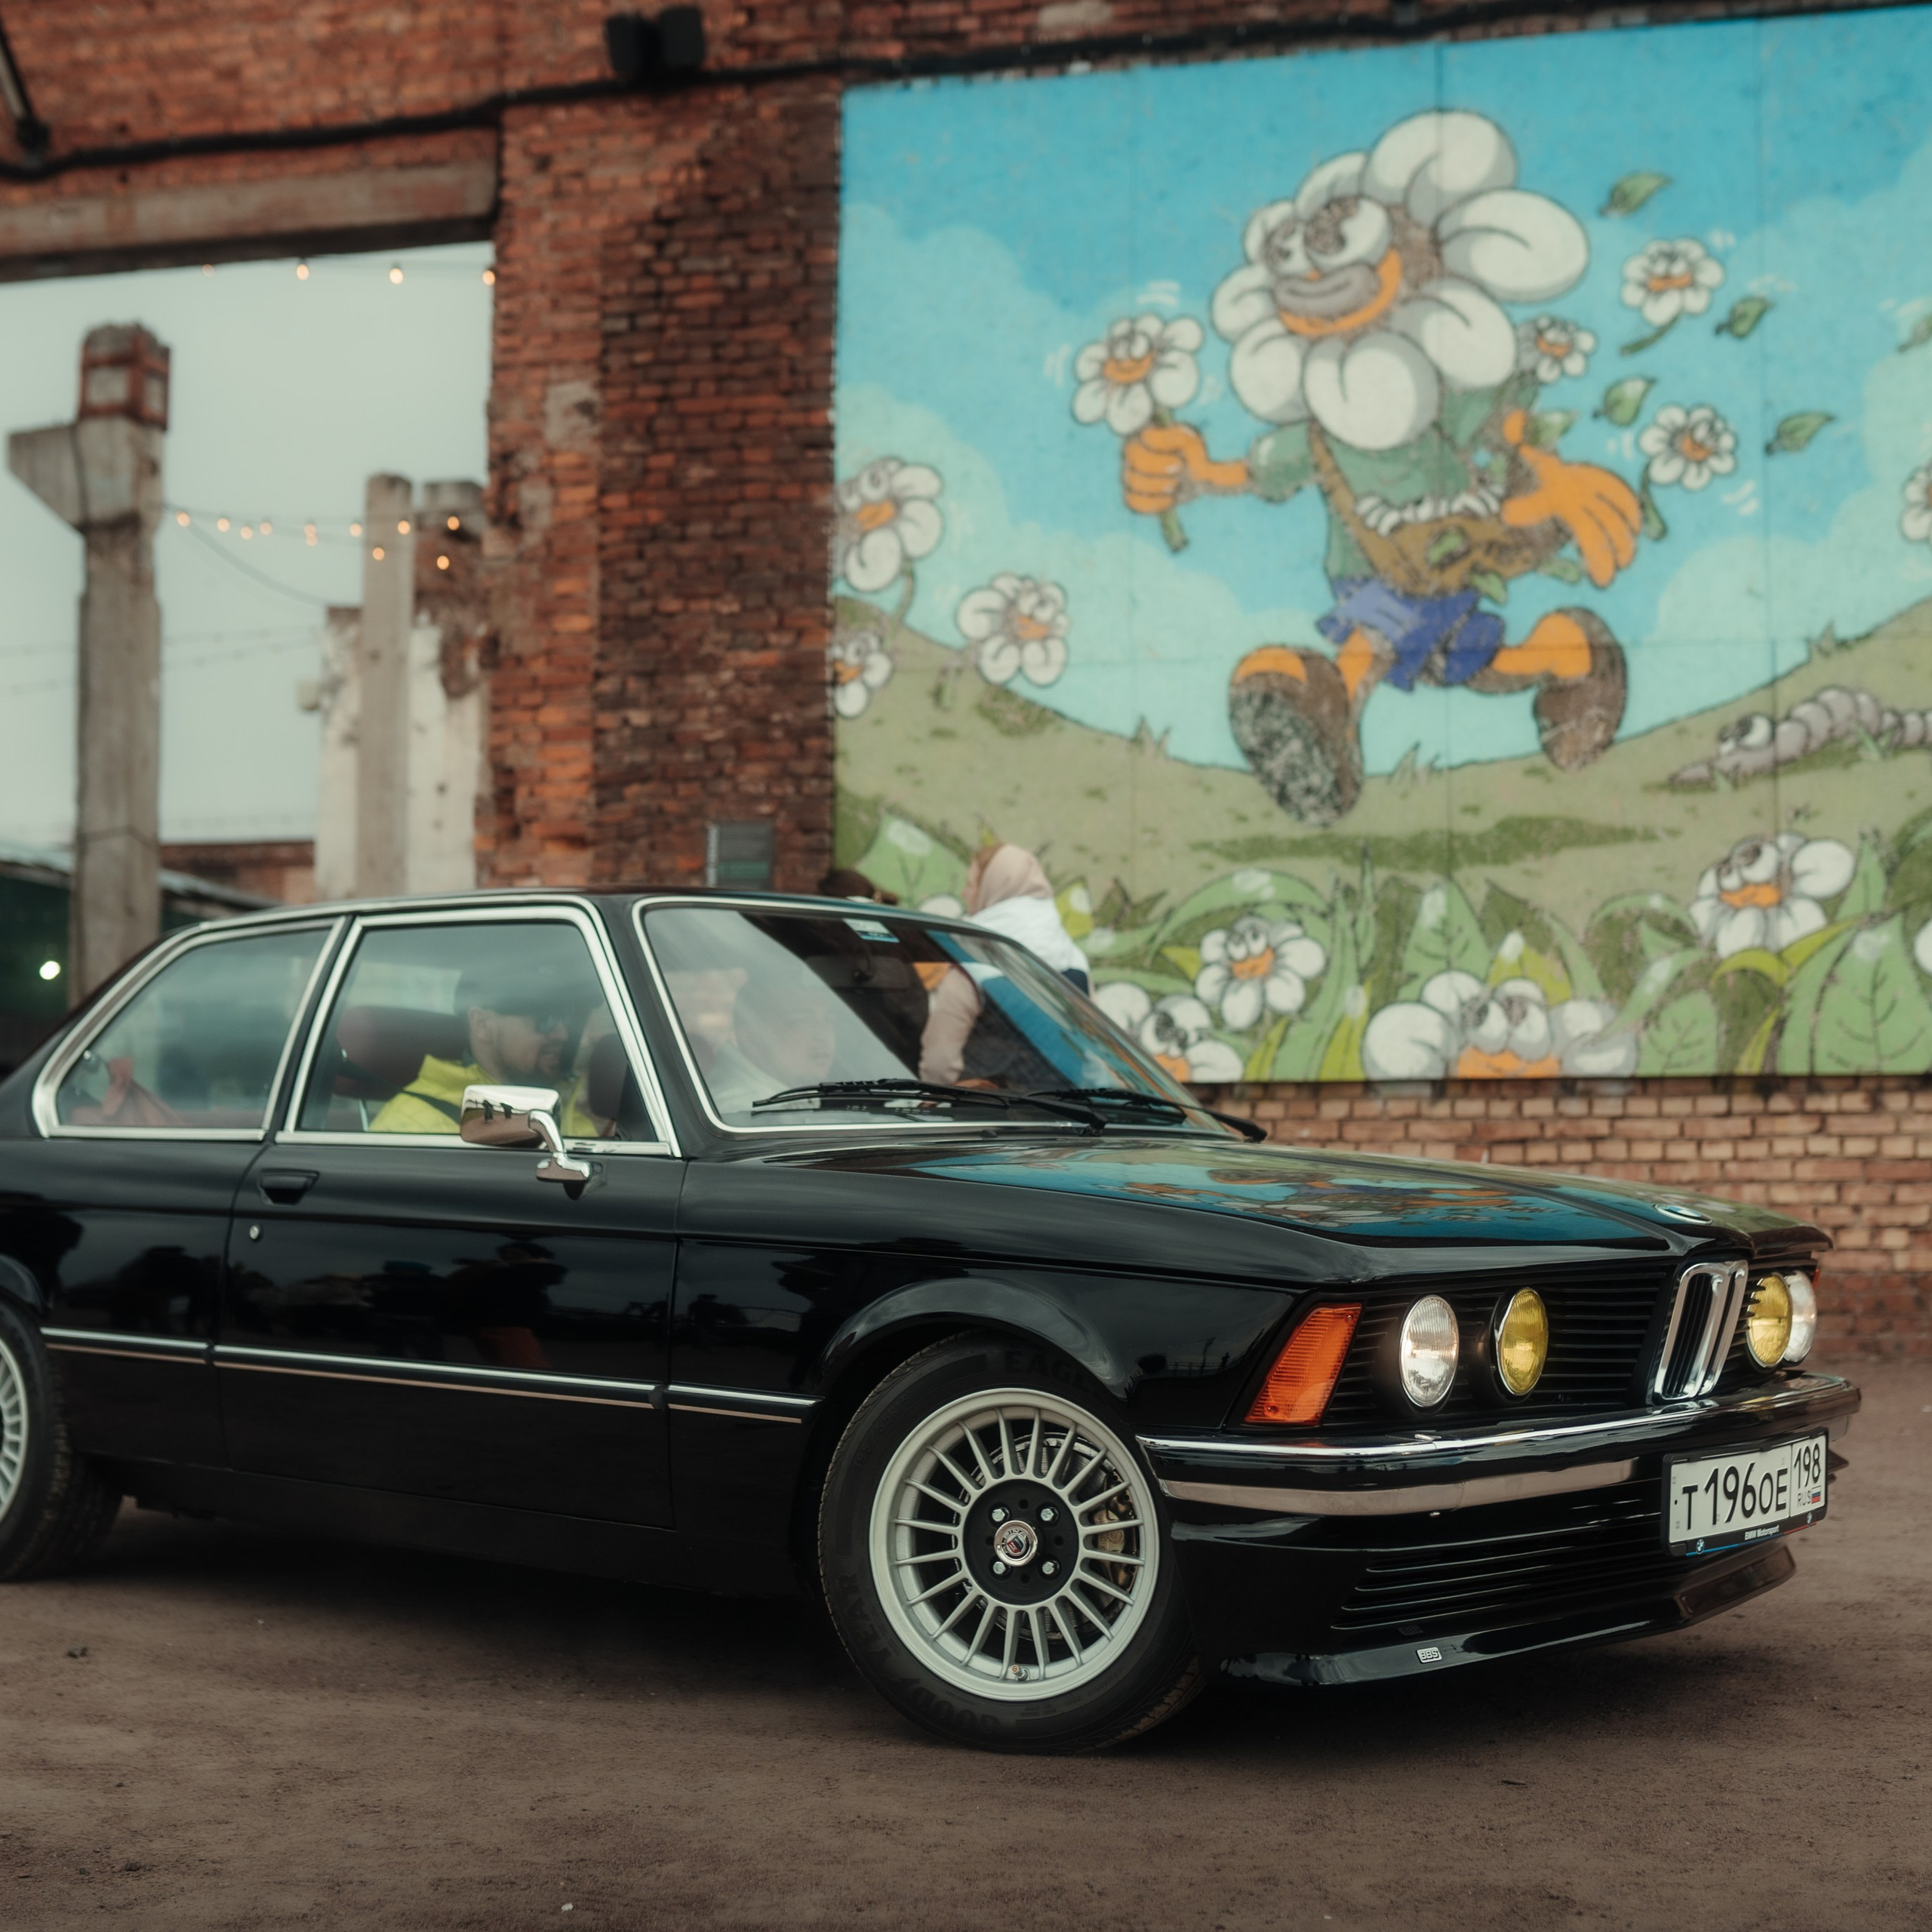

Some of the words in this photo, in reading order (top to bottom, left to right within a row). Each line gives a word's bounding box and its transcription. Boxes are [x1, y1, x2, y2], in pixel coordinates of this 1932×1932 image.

[1794, 1443, 1820, 1489] 198
[1797, 1491, 1810, 1507] RUS
[1420, 1650, 1438, 1660] BBS
